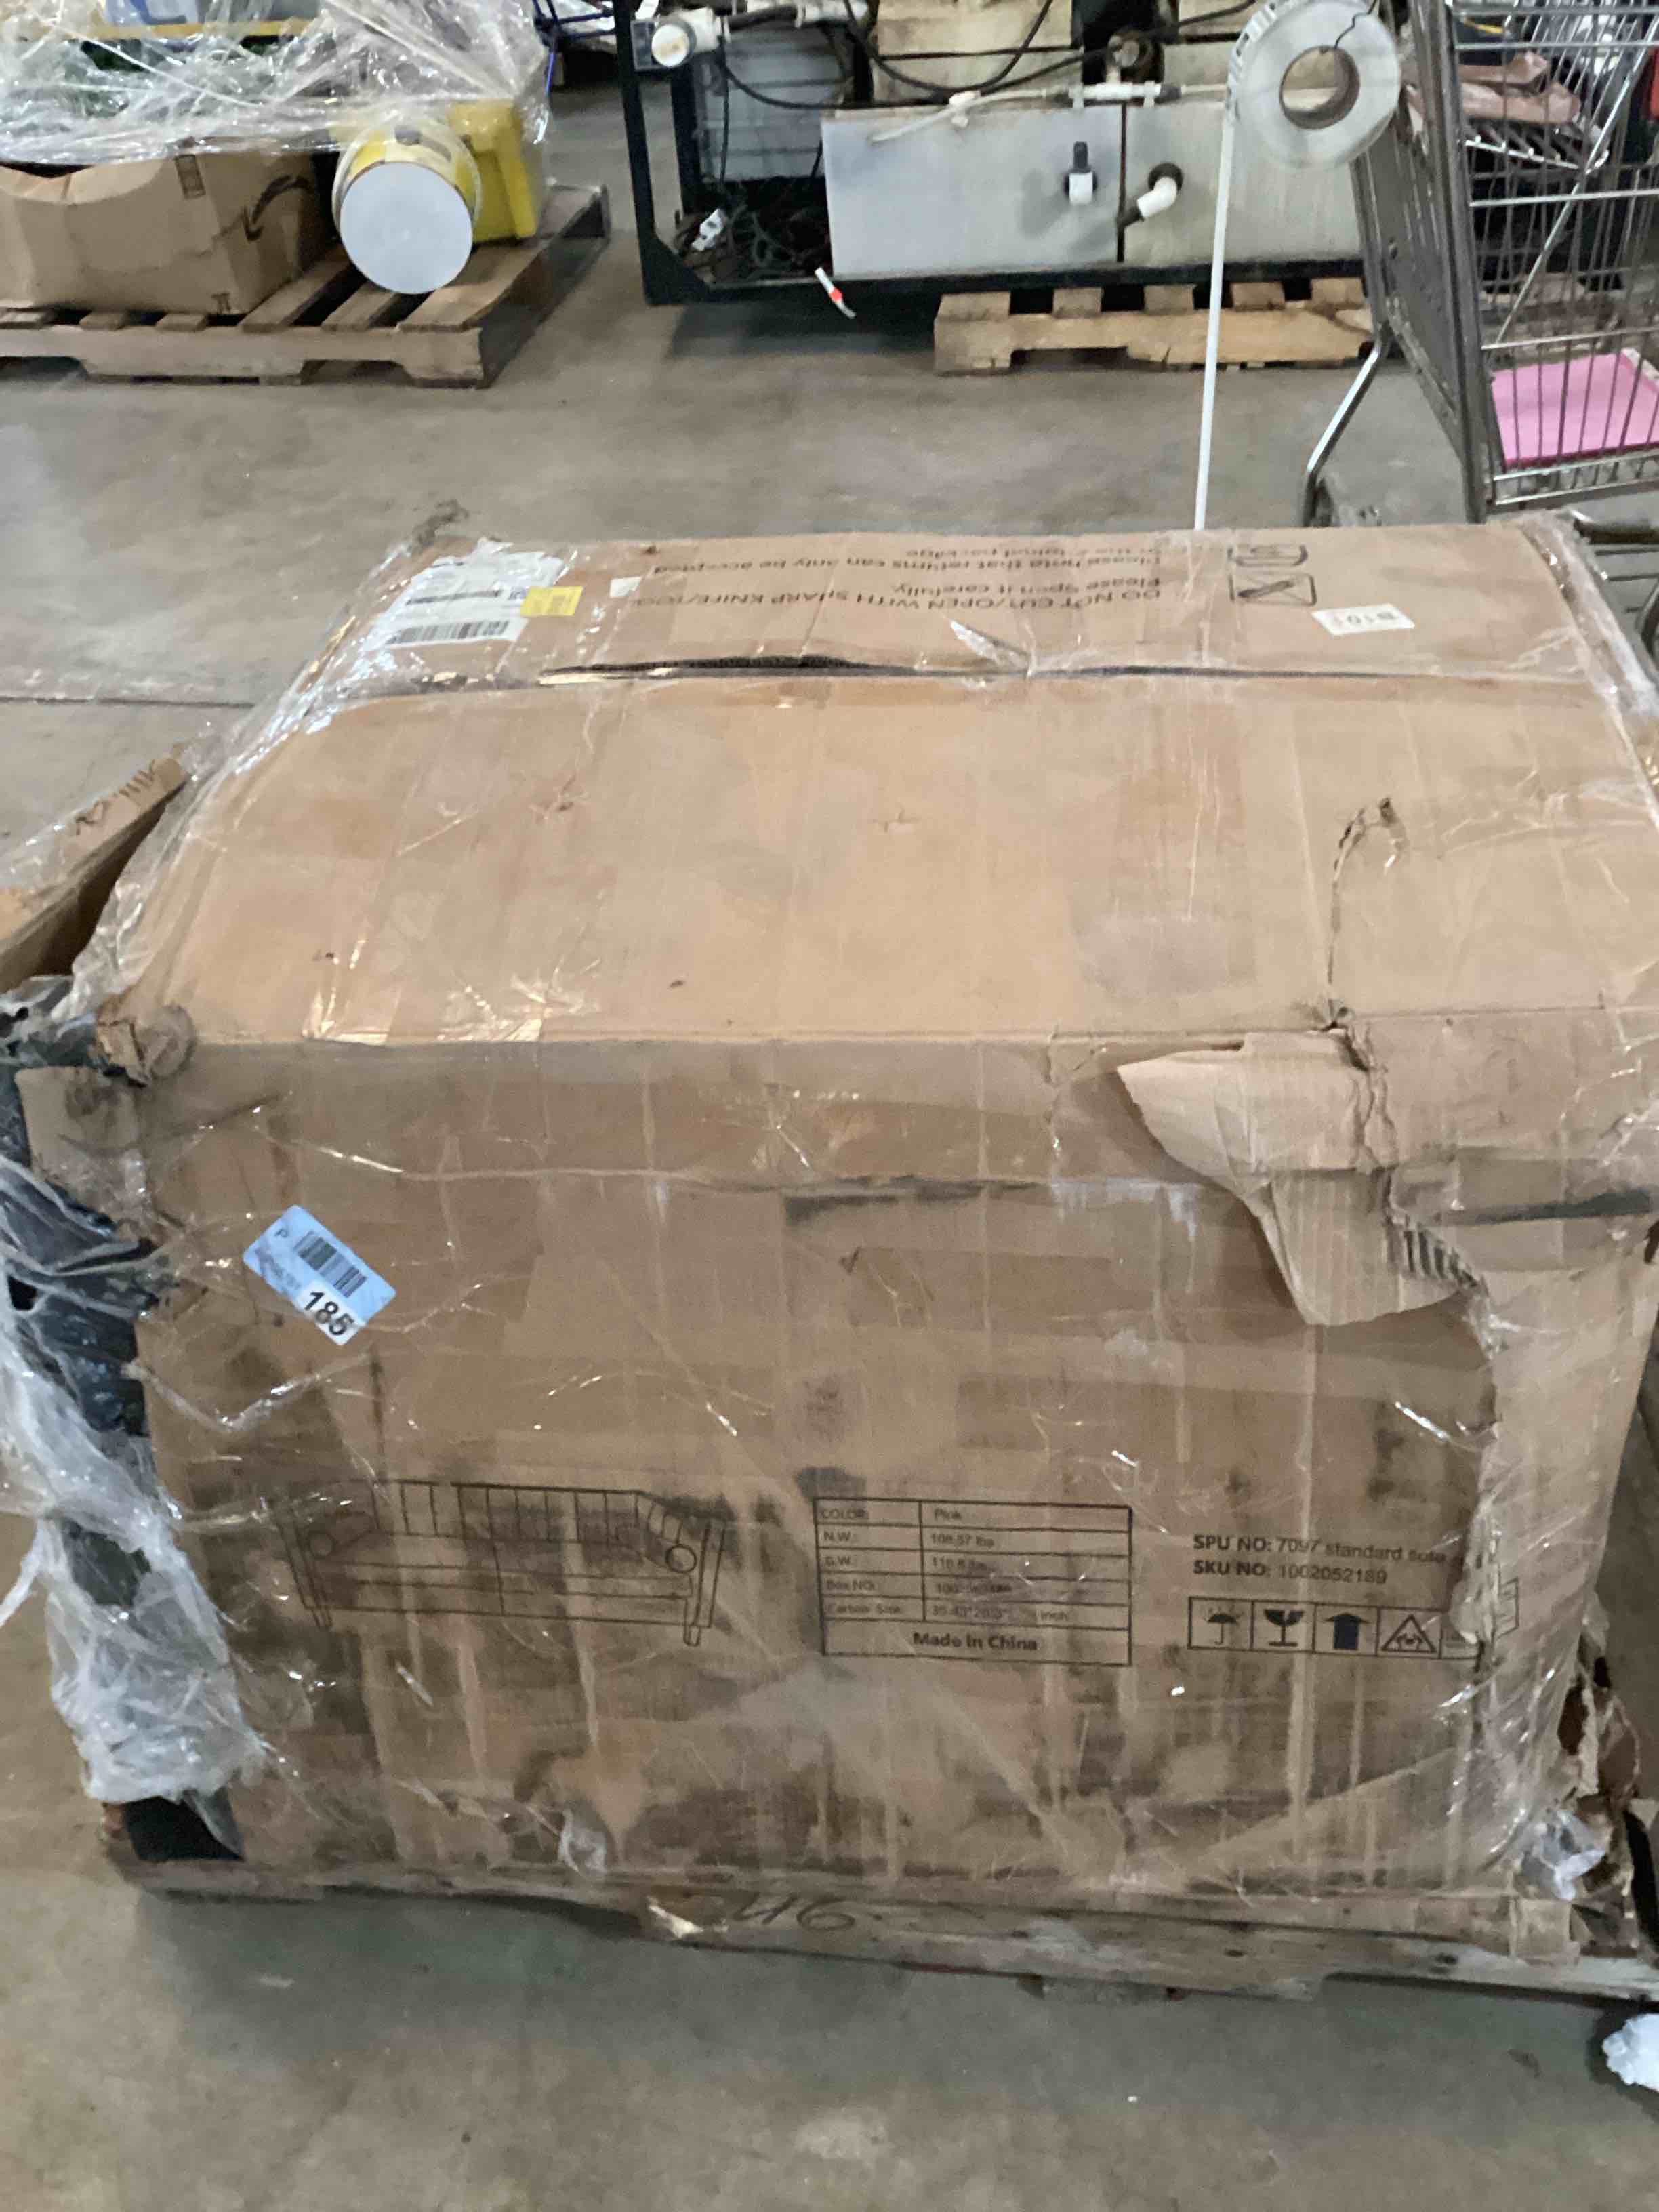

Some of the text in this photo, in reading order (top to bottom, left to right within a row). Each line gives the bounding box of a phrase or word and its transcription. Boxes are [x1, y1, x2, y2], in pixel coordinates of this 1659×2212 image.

[757, 557, 787, 569] be
[847, 557, 886, 568] can
[1086, 577, 1161, 588] Please
[771, 590, 850, 605] SHARP
[855, 593, 920, 609] WITH
[1060, 590, 1113, 609] NOT
[1122, 588, 1162, 601] DO
[303, 1290, 356, 1337] 185
[1193, 1535, 1231, 1551] SPU
[1237, 1536, 1272, 1552] NO:
[1324, 1542, 1404, 1561] standard
[1193, 1560, 1231, 1576] SKU
[1236, 1561, 1271, 1578] NO:
[912, 1631, 962, 1648] Made
[988, 1634, 1038, 1652] China
